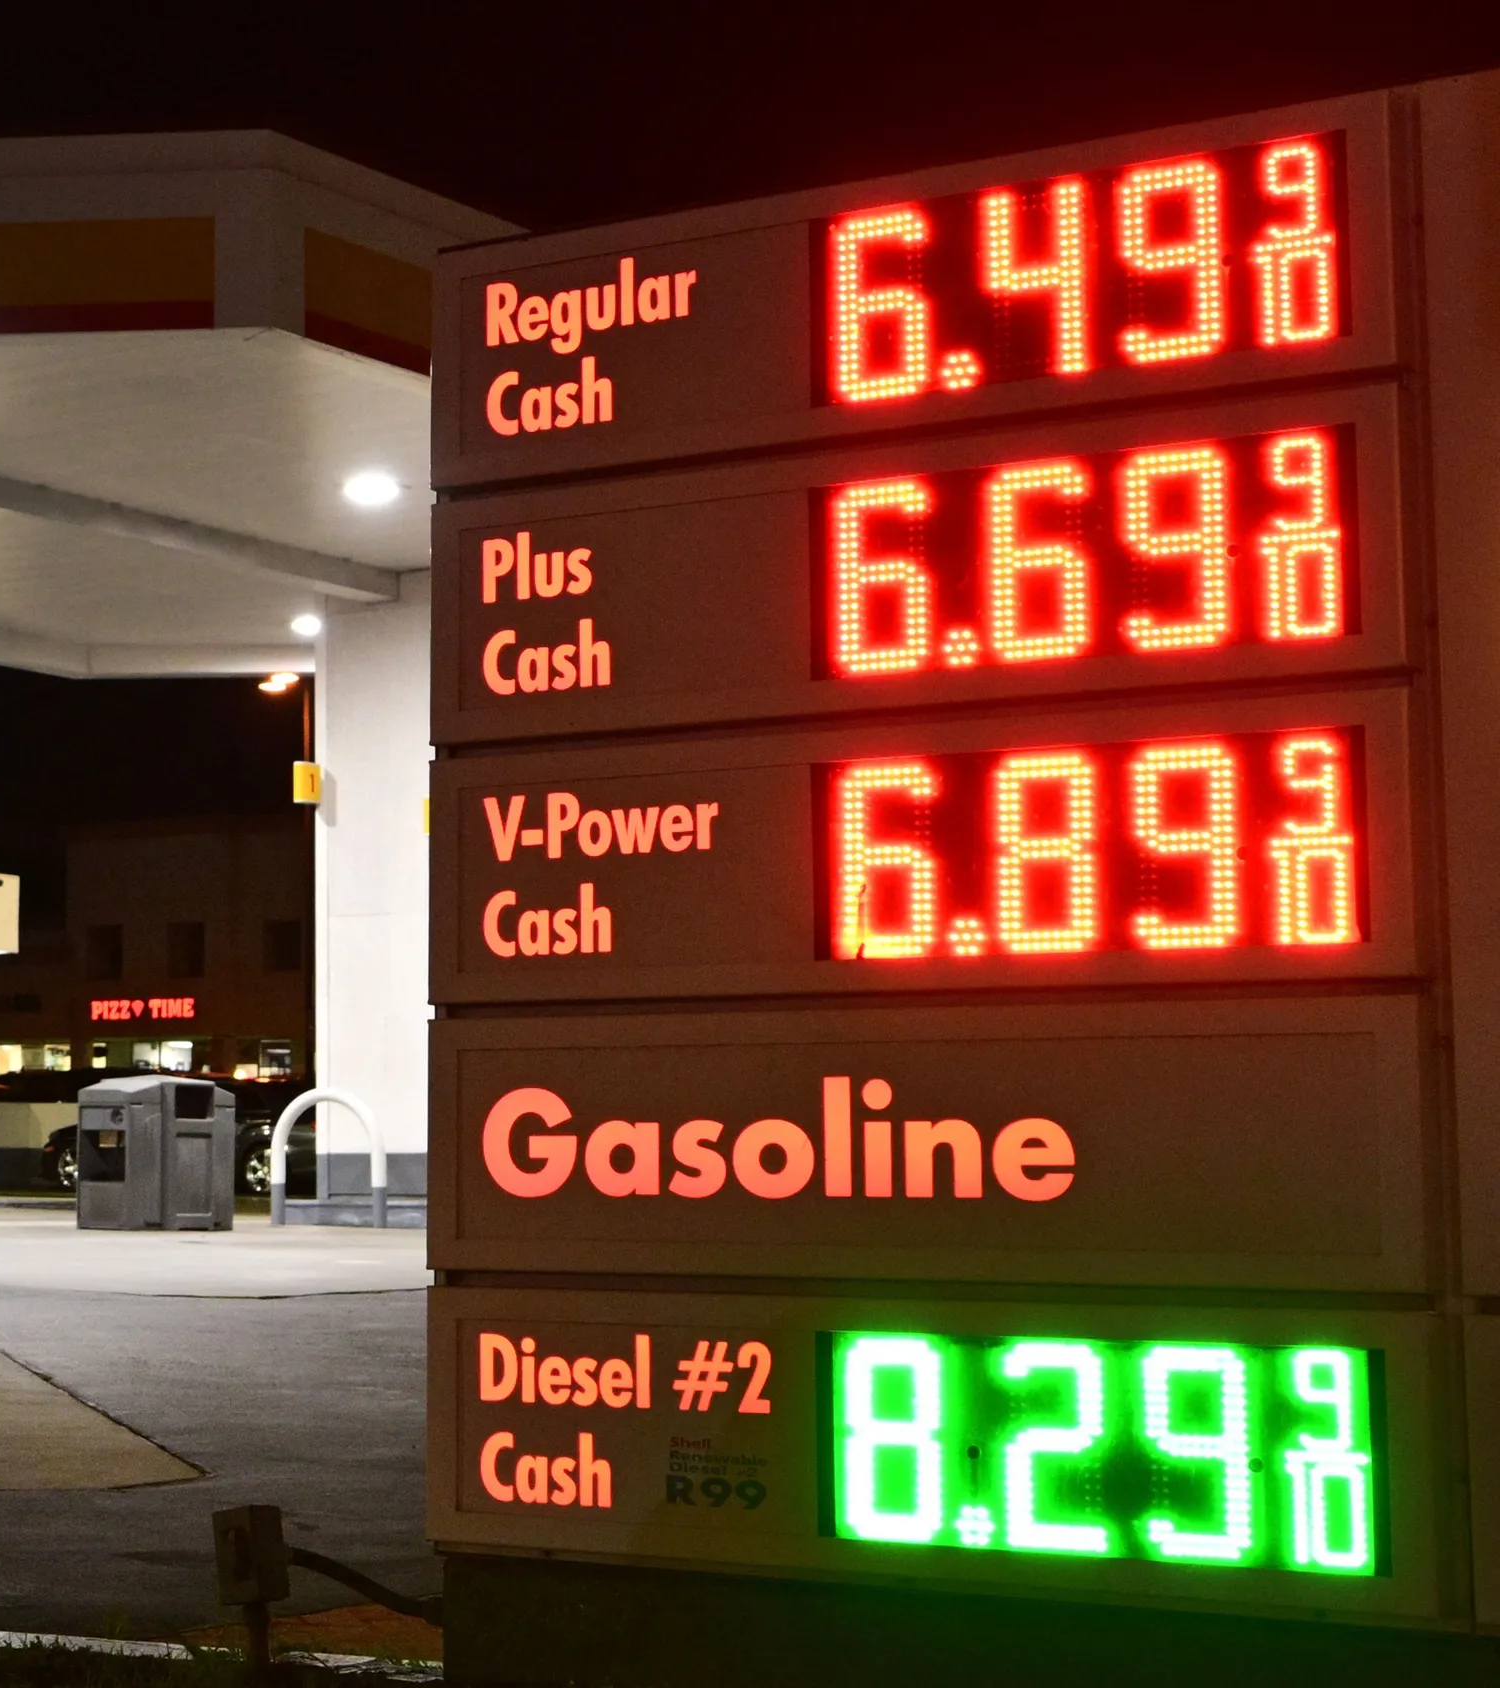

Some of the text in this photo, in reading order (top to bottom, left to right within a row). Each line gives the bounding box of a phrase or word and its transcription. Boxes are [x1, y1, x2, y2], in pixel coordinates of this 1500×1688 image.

[485, 256, 697, 355] Regular
[835, 160, 1223, 403] 6.49
[485, 355, 614, 437] Cash
[482, 531, 593, 604] Plus
[837, 447, 1227, 674] 6.69
[482, 617, 612, 697] Cash
[483, 792, 719, 862] V-Power
[842, 746, 1238, 958] 6.89
[483, 882, 613, 958] Cash
[148, 997, 195, 1019] TIME
[482, 1075, 1076, 1202] Gasoline
[479, 1332, 772, 1414] Diesel #2
[479, 1431, 612, 1508] Cash
[669, 1436, 712, 1450] Shell
[669, 1449, 768, 1468] Renewable
[669, 1461, 728, 1476] Diesel
[845, 1336, 1253, 1560] 8.29
[665, 1473, 768, 1511] R99
